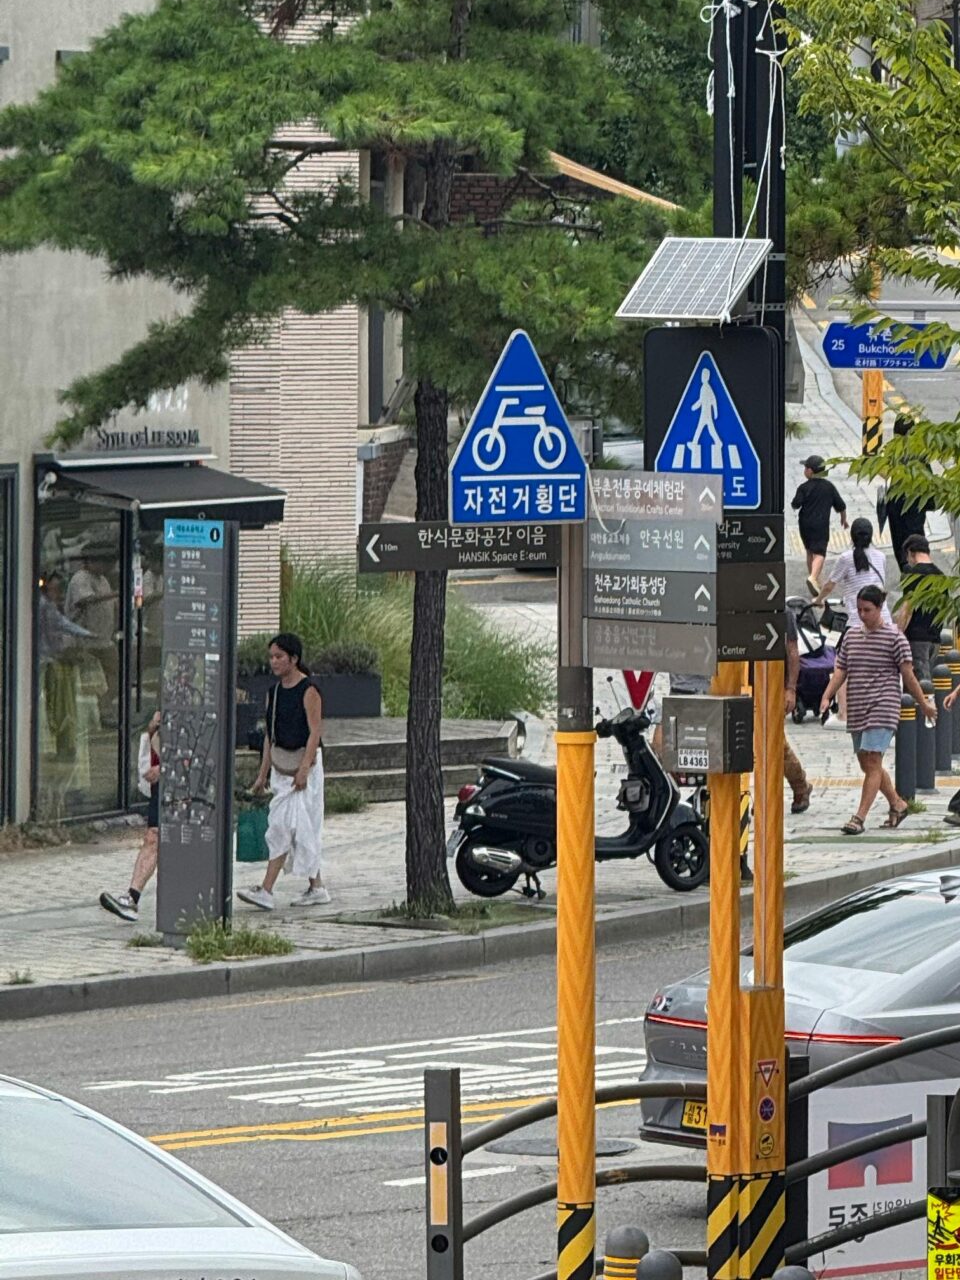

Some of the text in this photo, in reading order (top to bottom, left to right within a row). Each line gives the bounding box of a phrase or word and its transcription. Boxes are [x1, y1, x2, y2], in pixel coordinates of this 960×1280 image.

[832, 339, 844, 350] 25
[592, 478, 684, 501] 북촌전통공예체험관
[464, 484, 578, 515] 자전거횡단
[665, 505, 683, 516] Center
[418, 525, 546, 548] 한식문화공간 이음
[640, 529, 684, 549] 안국선원
[380, 543, 397, 551] 110m
[459, 551, 490, 563] HANSIK
[492, 551, 517, 564] Space
[595, 574, 667, 595] 천주교가회동성당
[722, 645, 745, 655] Center
[679, 756, 708, 767] LB 4363
